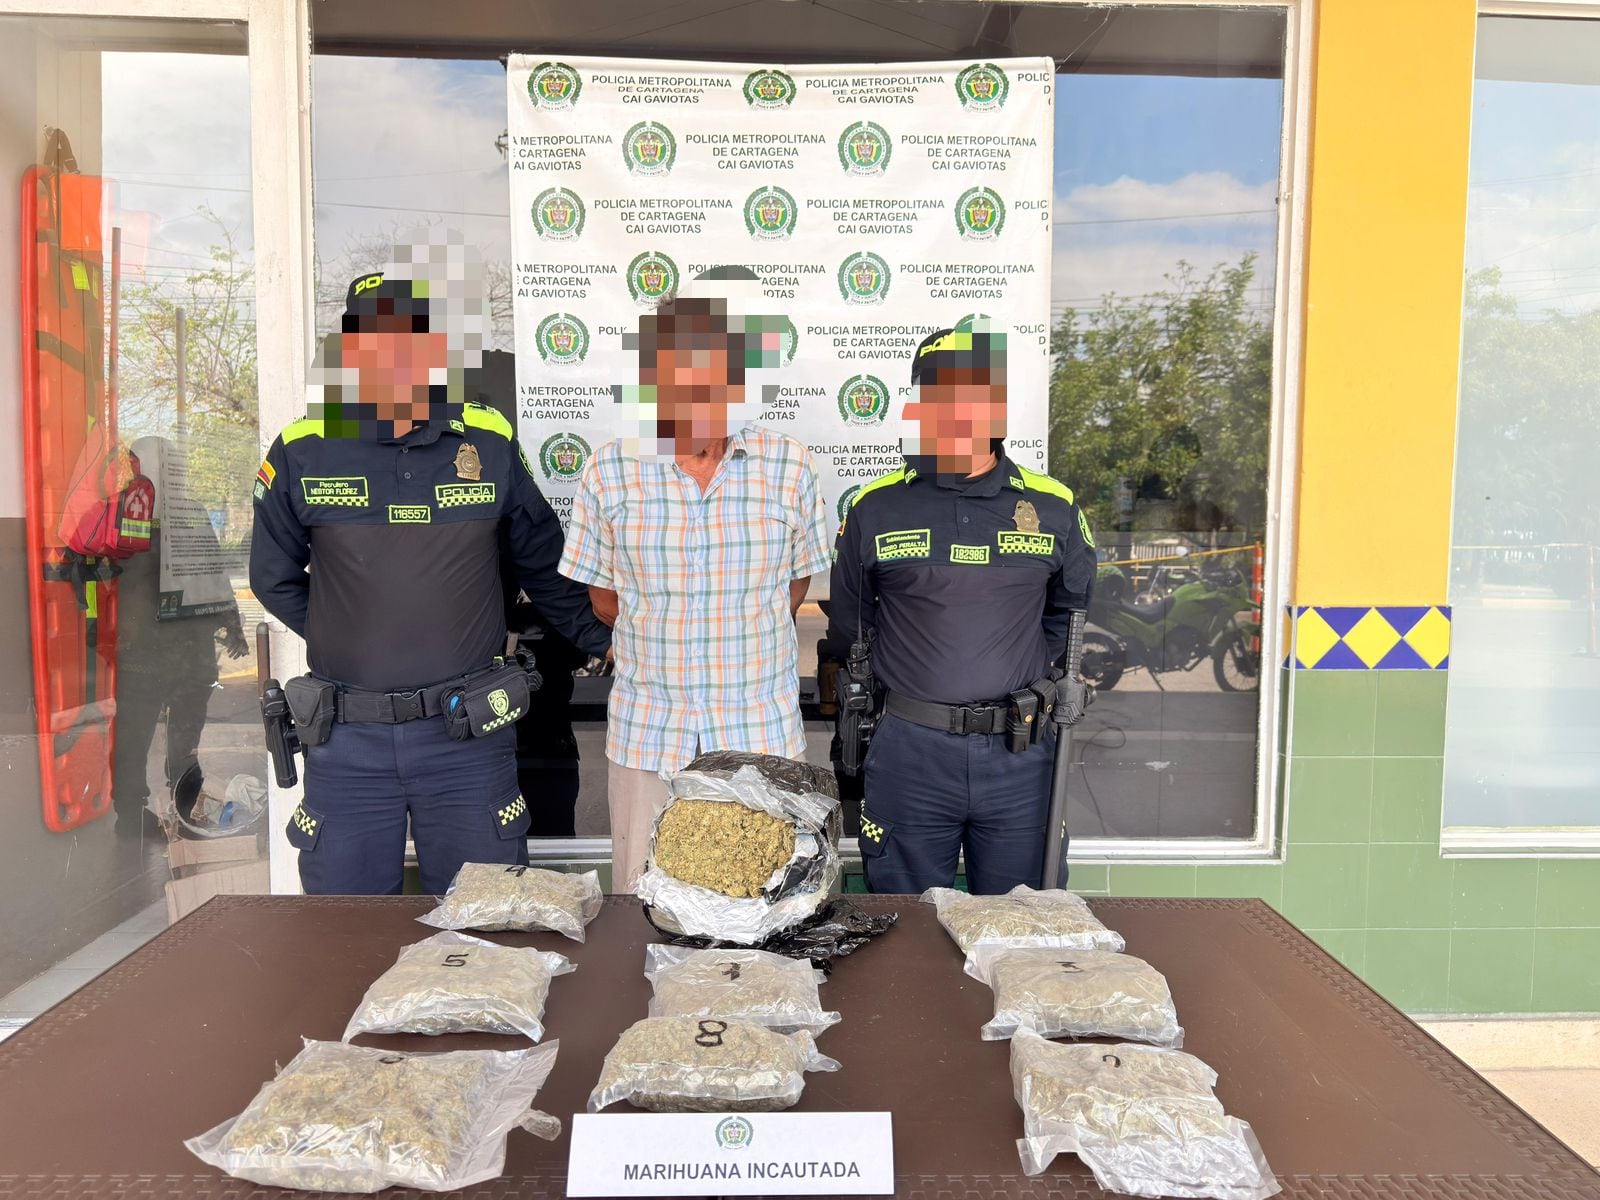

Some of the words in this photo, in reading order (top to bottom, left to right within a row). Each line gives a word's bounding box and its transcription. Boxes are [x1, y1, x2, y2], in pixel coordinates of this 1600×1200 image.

[591, 74, 636, 84] POLICIA
[638, 77, 732, 88] METROPOLITANA
[805, 78, 850, 88] POLICIA
[851, 76, 945, 86] METROPOLITANA
[635, 86, 705, 94] CARTAGENA
[850, 86, 919, 95] CARTAGENA
[622, 94, 641, 104] CAI
[644, 94, 700, 104] GAVIOTAS
[837, 95, 856, 104] CAI
[859, 95, 914, 104] GAVIOTAS
[520, 135, 613, 146] METROPOLITANA
[685, 134, 730, 144] POLICIA
[732, 134, 826, 144] METROPOLITANA
[901, 134, 945, 145] POLICIA
[947, 135, 1037, 147] METROPOLITANA
[518, 148, 586, 158] CARTAGENA
[712, 147, 728, 157] DE
[730, 146, 799, 157] CARTAGENA
[927, 147, 942, 158] DE
[944, 148, 1011, 158] CARTAGENA
[527, 160, 582, 171] GAVIOTAS
[717, 159, 737, 170] CAI
[739, 159, 794, 170] GAVIOTAS
[931, 160, 951, 170] CAI
[953, 161, 1007, 171] GAVIOTAS
[594, 199, 637, 209] POLICIA
[639, 198, 733, 209] METROPOLITANA
[806, 199, 851, 209] POLICIA
[852, 199, 945, 209] METROPOLITANA
[620, 211, 636, 222] DE
[638, 211, 707, 221] CARTAGENA
[833, 211, 848, 222] DE
[850, 211, 918, 222] CARTAGENA
[625, 224, 644, 234] CAI
[646, 224, 702, 234] GAVIOTAS
[837, 224, 856, 234] CAI
[858, 224, 913, 234] GAVIOTAS
[524, 263, 618, 274] METROPOLITANA
[900, 263, 943, 274] POLICIA
[945, 264, 1035, 274] METROPOLITANA
[522, 276, 592, 286] CARTAGENA
[925, 276, 940, 286] DE
[942, 276, 1008, 287] CARTAGENA
[531, 288, 587, 299] GAVIOTAS
[930, 288, 948, 299] CAI
[950, 289, 1003, 299] GAVIOTAS
[807, 326, 850, 335] POLICIA
[833, 337, 848, 347] DE
[850, 337, 917, 347] CARTAGENA
[837, 350, 856, 360] CAI
[858, 350, 912, 360] GAVIOTAS
[526, 397, 595, 408] CARTAGENA
[535, 410, 590, 420] GAVIOTAS
[807, 445, 850, 455] POLICIA
[832, 456, 847, 466] DE
[837, 468, 855, 478] CAI
[335, 487, 359, 496] FLOREZ
[393, 509, 428, 520] 116557
[441, 953, 470, 968] 5
[694, 1019, 728, 1048] 8
[623, 1162, 742, 1181] MARIHUANA
[747, 1160, 862, 1179] INCAUTADA
